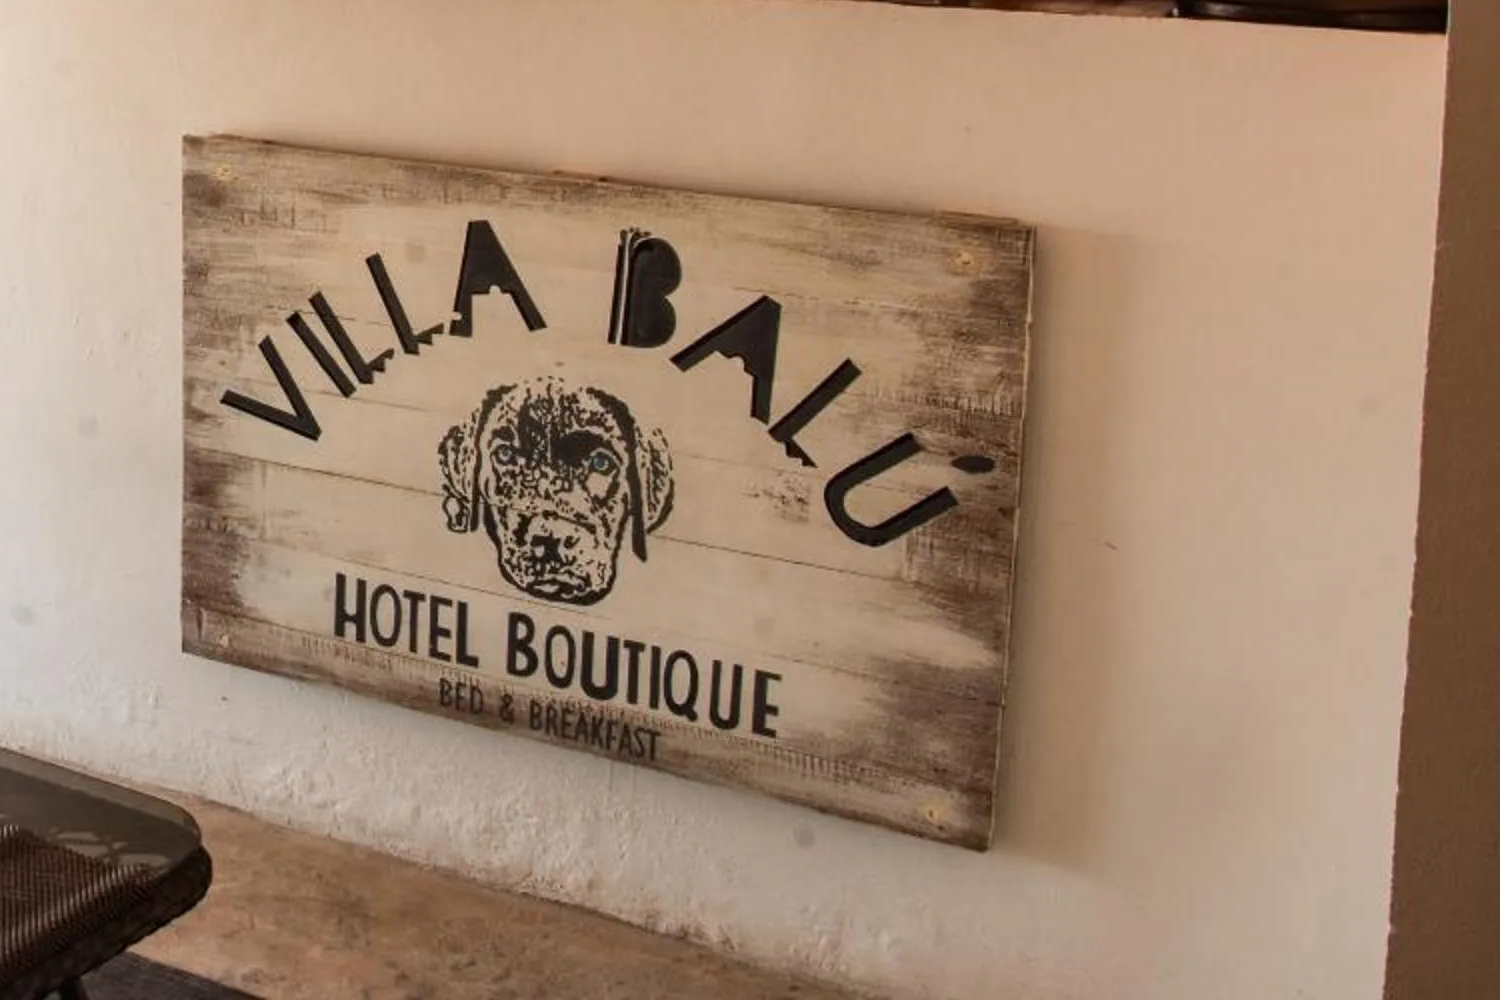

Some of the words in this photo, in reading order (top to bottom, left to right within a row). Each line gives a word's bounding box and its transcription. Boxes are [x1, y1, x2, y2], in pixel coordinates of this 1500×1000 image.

[220, 219, 547, 442] VILLA
[334, 572, 480, 669] HOTEL
[506, 611, 783, 740] BOUTIQUE
[439, 677, 484, 715] BED
[500, 693, 515, 725] &
[529, 697, 661, 762] BREAKFAST
